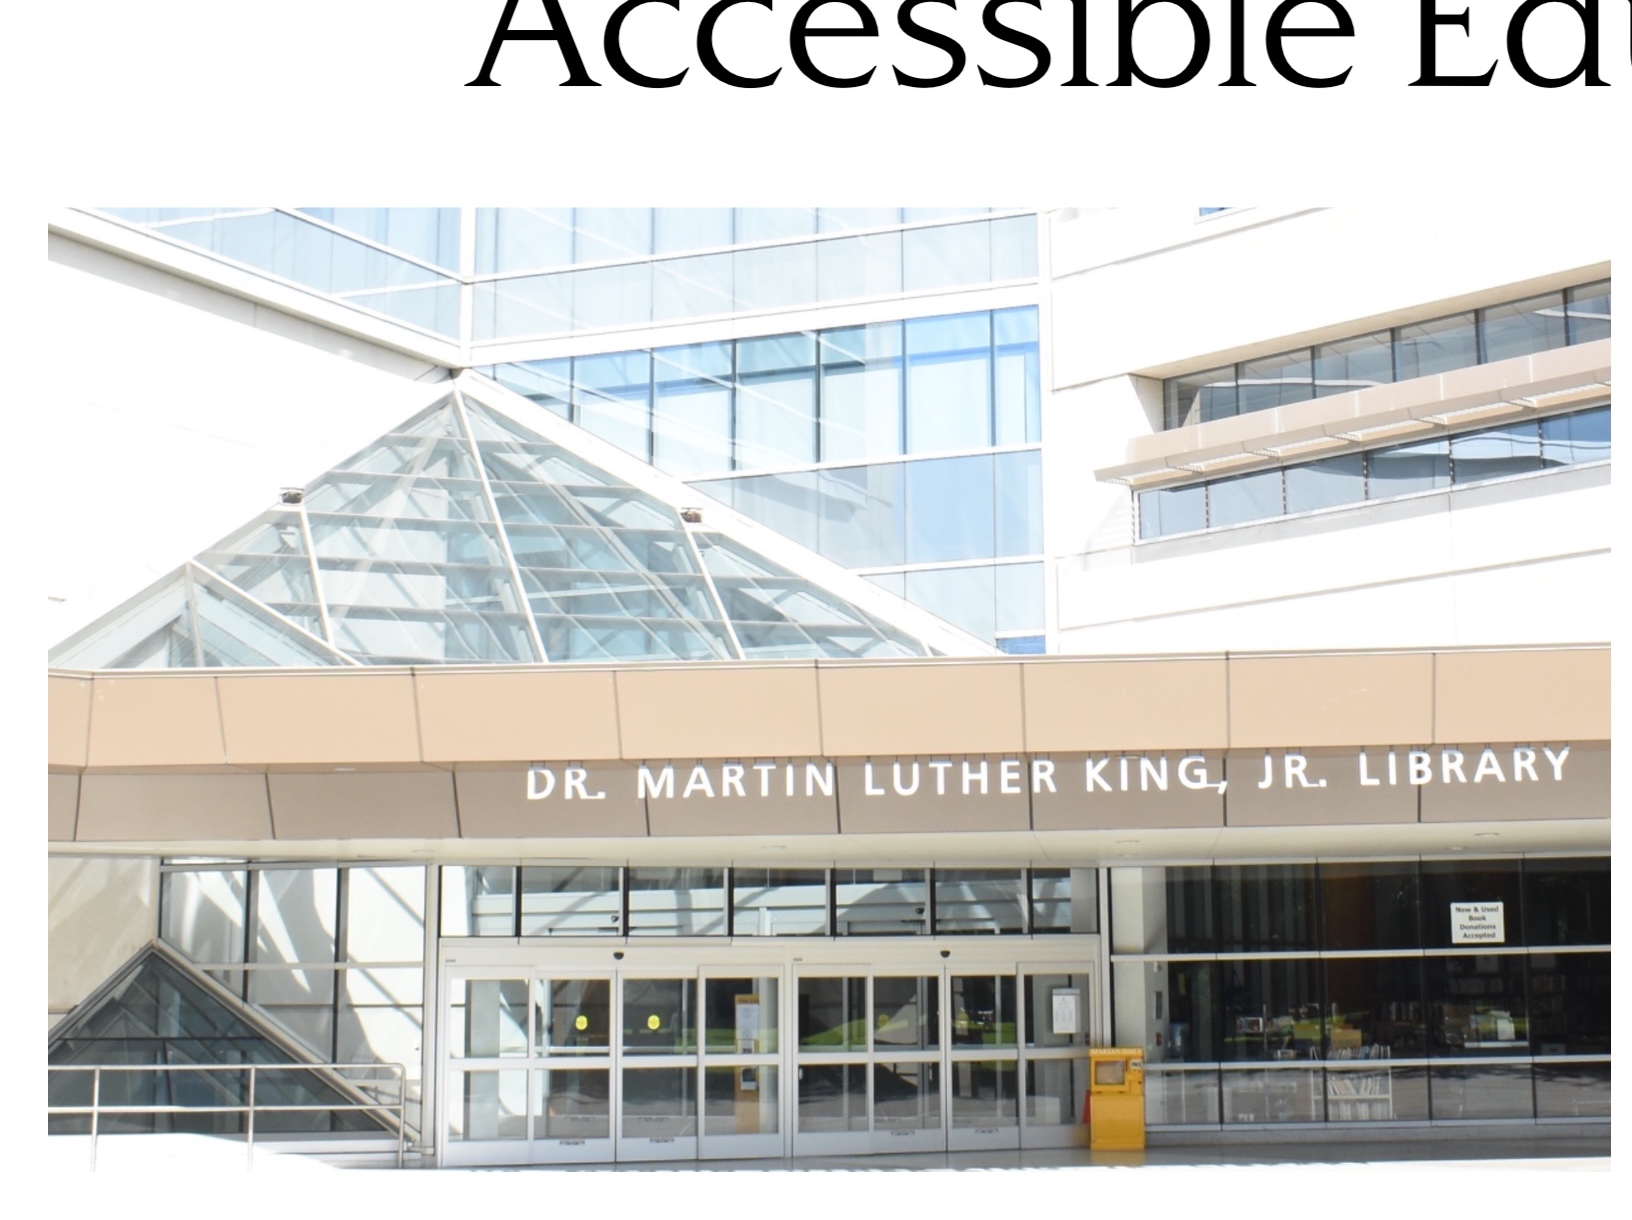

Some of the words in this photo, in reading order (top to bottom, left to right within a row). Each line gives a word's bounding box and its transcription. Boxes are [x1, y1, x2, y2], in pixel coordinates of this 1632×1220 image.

[526, 767, 607, 800] DR.
[636, 763, 835, 799] MARTIN
[863, 760, 1058, 796] LUTHER
[1084, 754, 1228, 795] KING,
[1257, 753, 1328, 789] JR.
[1358, 746, 1572, 786] LIBRARY
[1481, 905, 1499, 913] Used
[1462, 932, 1496, 940] Accepted
